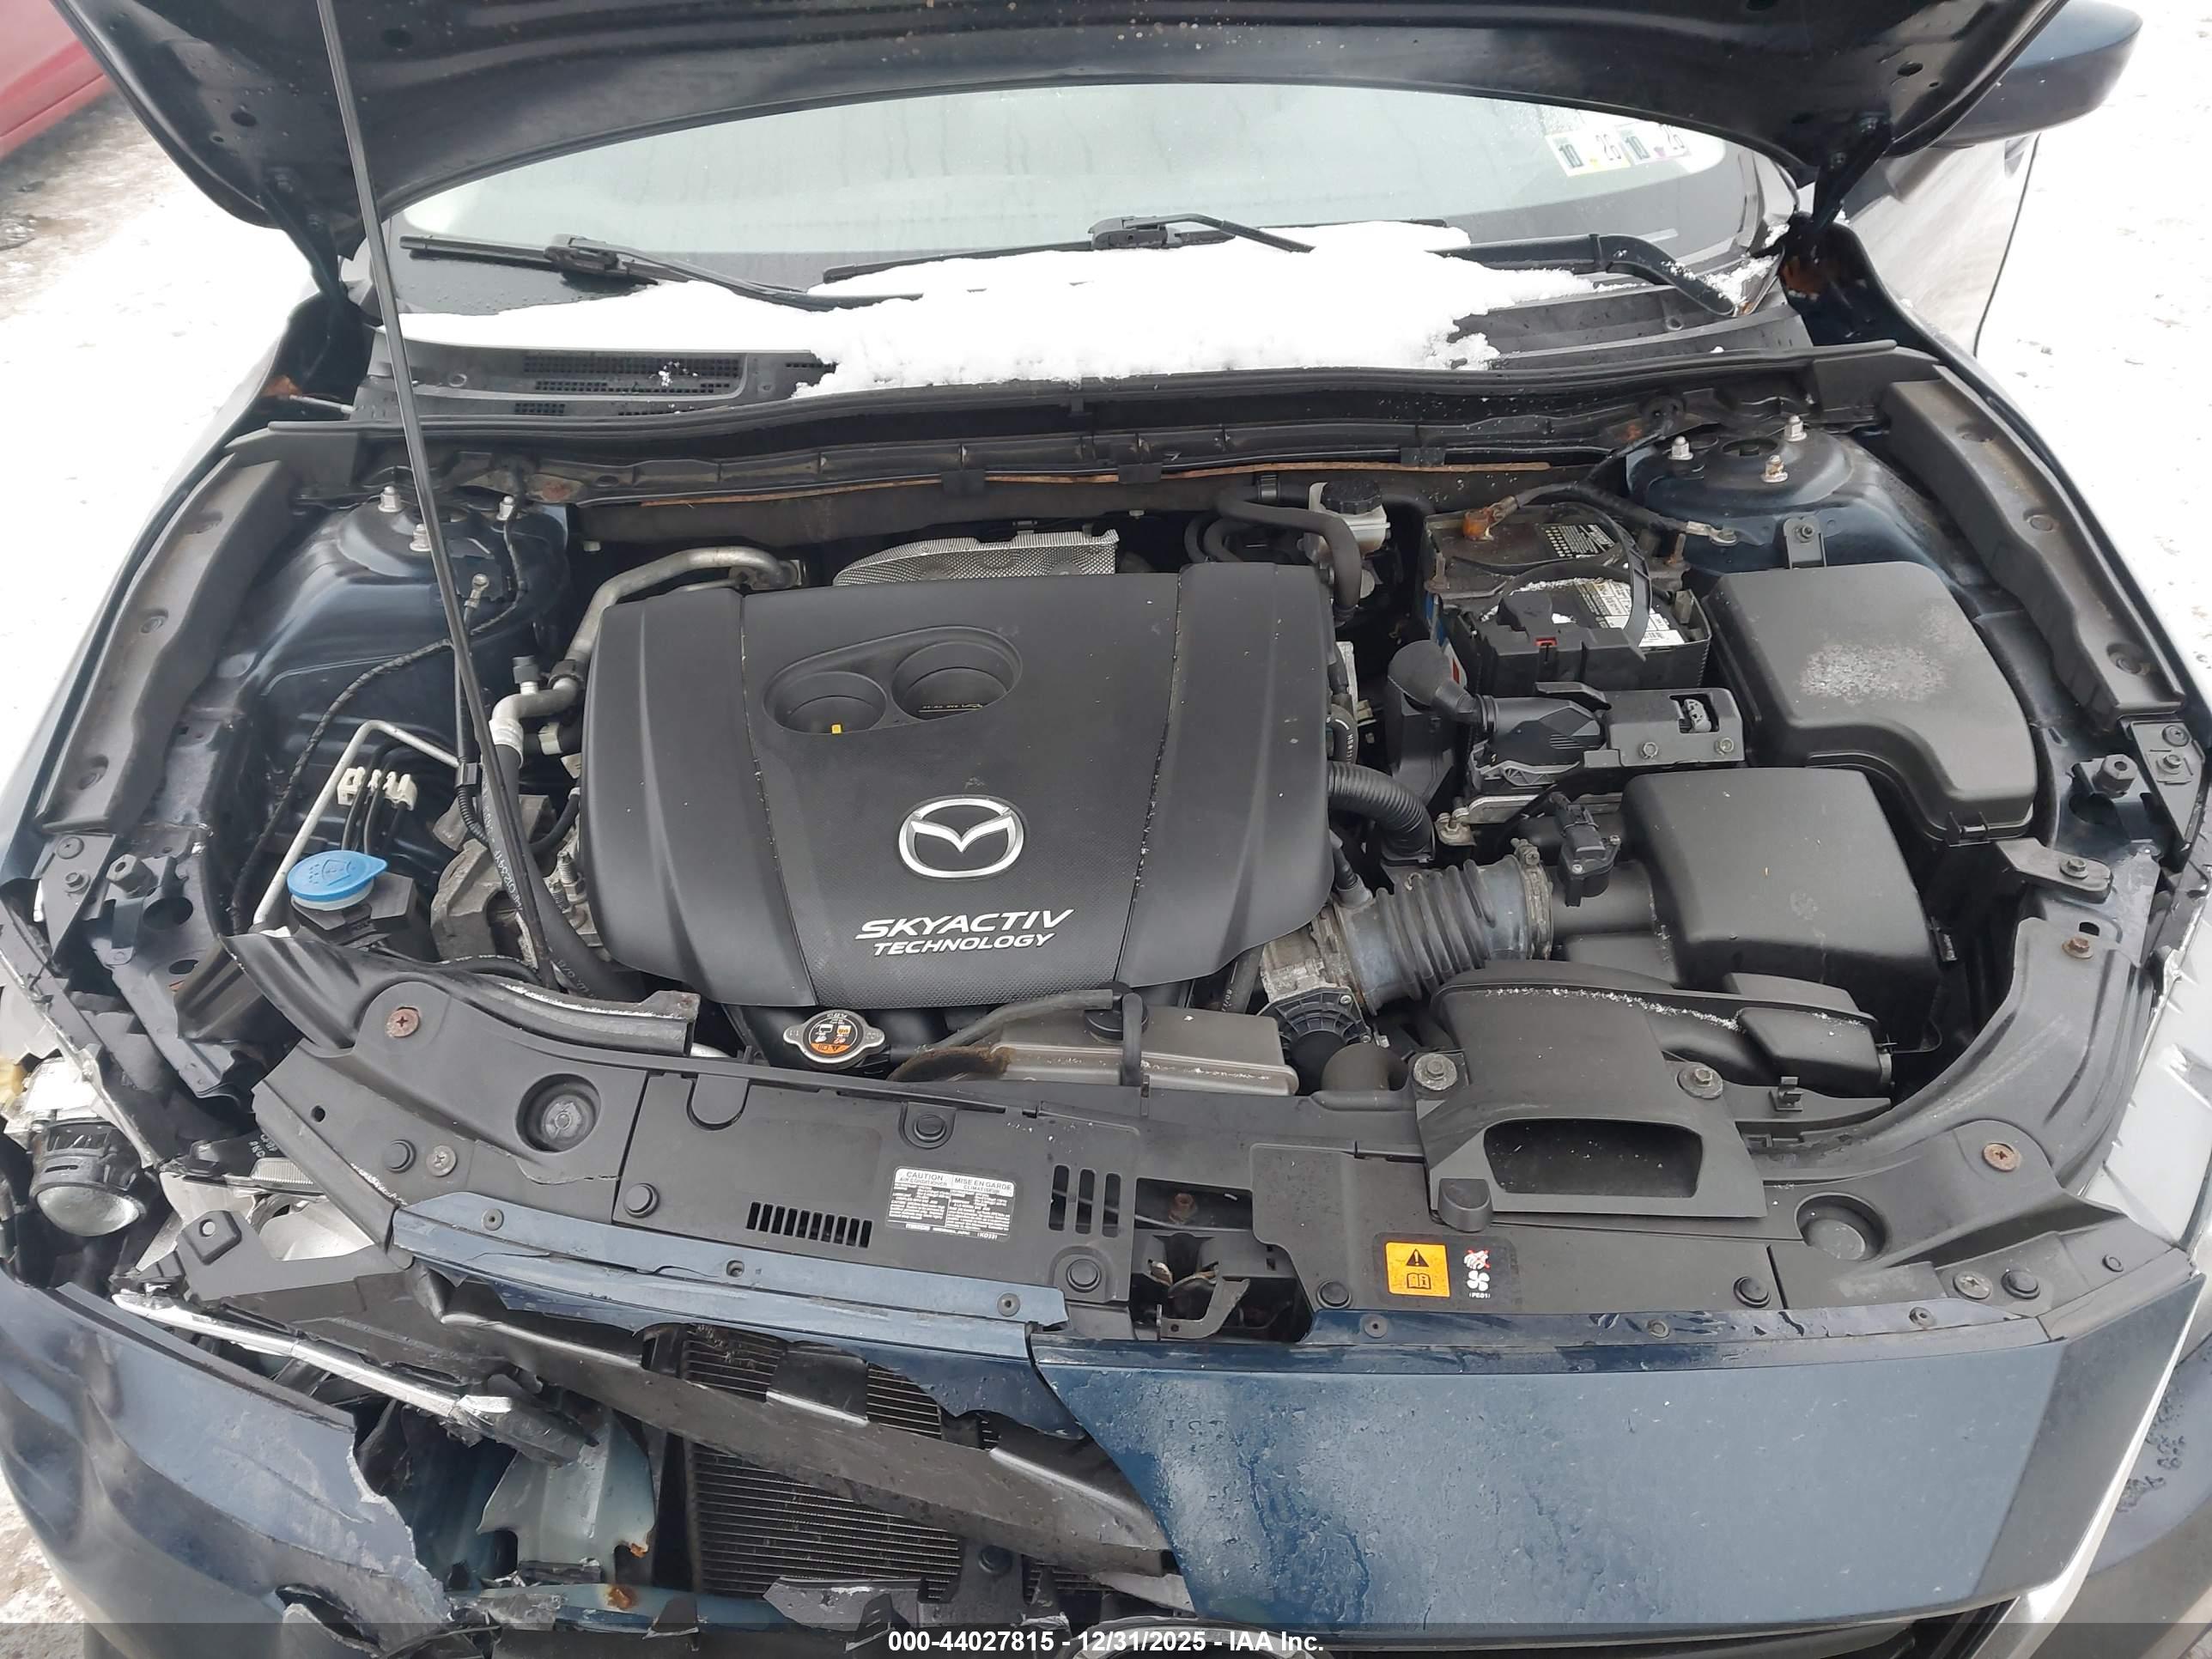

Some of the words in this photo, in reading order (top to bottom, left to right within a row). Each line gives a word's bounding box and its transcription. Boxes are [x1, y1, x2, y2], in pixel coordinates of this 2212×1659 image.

[855, 908, 1074, 939] SKYACTIV
[873, 933, 1056, 957] TECHNOLOGY
[906, 1171, 944, 1182] CAUTION
[986, 1182, 1012, 1190] GARDE
